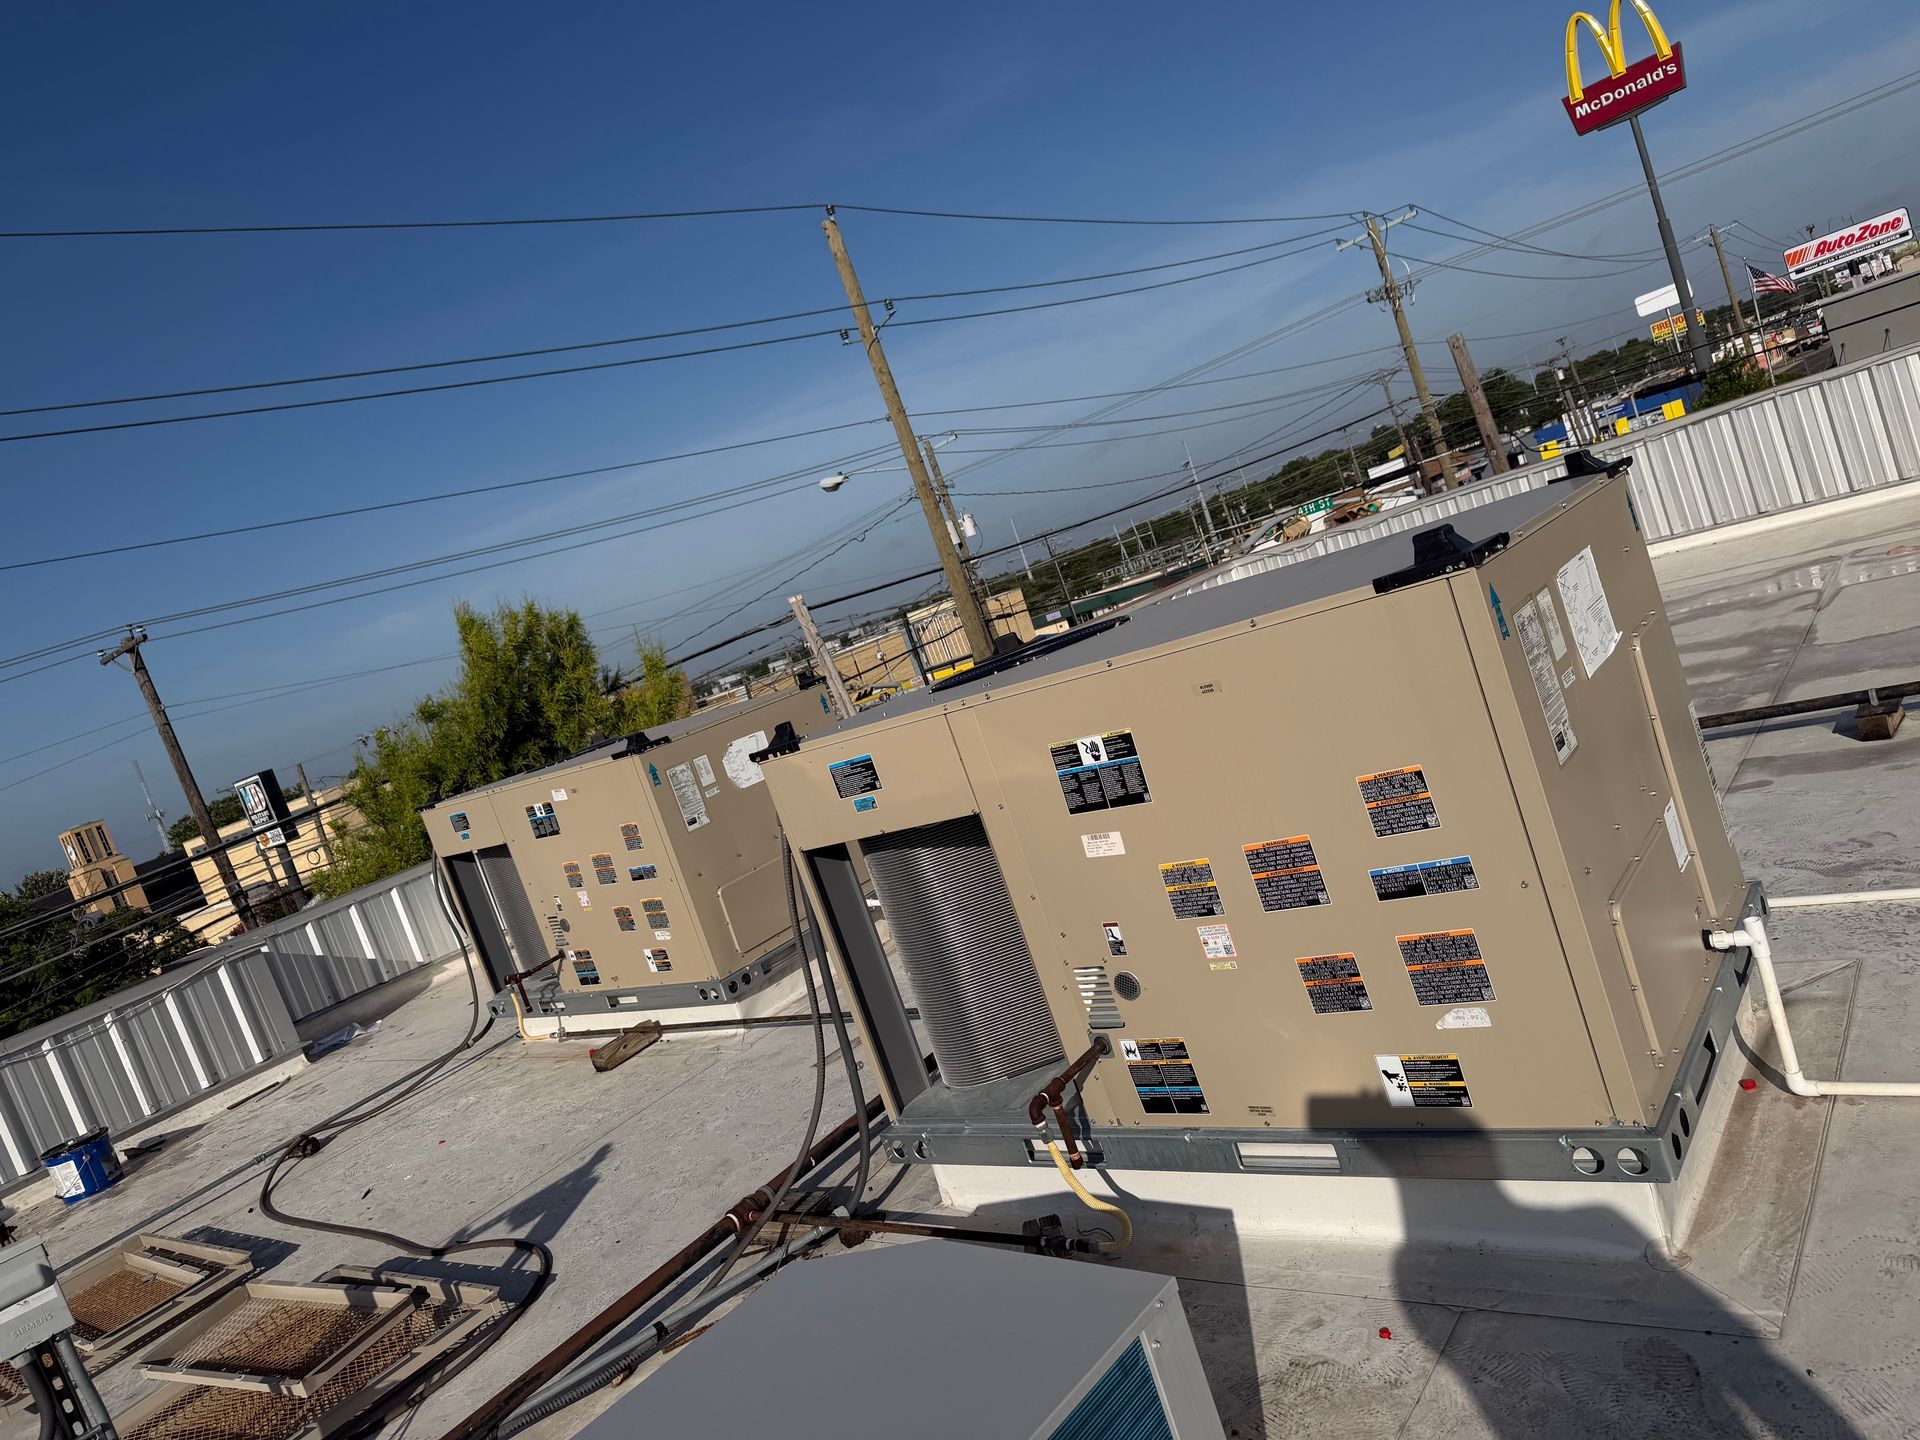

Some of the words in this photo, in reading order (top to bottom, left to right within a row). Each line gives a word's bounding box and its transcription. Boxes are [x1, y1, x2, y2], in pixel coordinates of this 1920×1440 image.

[1575, 63, 1677, 119] McDonald's
[1813, 216, 1902, 259] AutoZone
[1298, 503, 1316, 514] 4TH
[1319, 498, 1330, 509] ST
[1377, 769, 1405, 778] WARNING
[10, 1312, 54, 1338] SIEMENS
